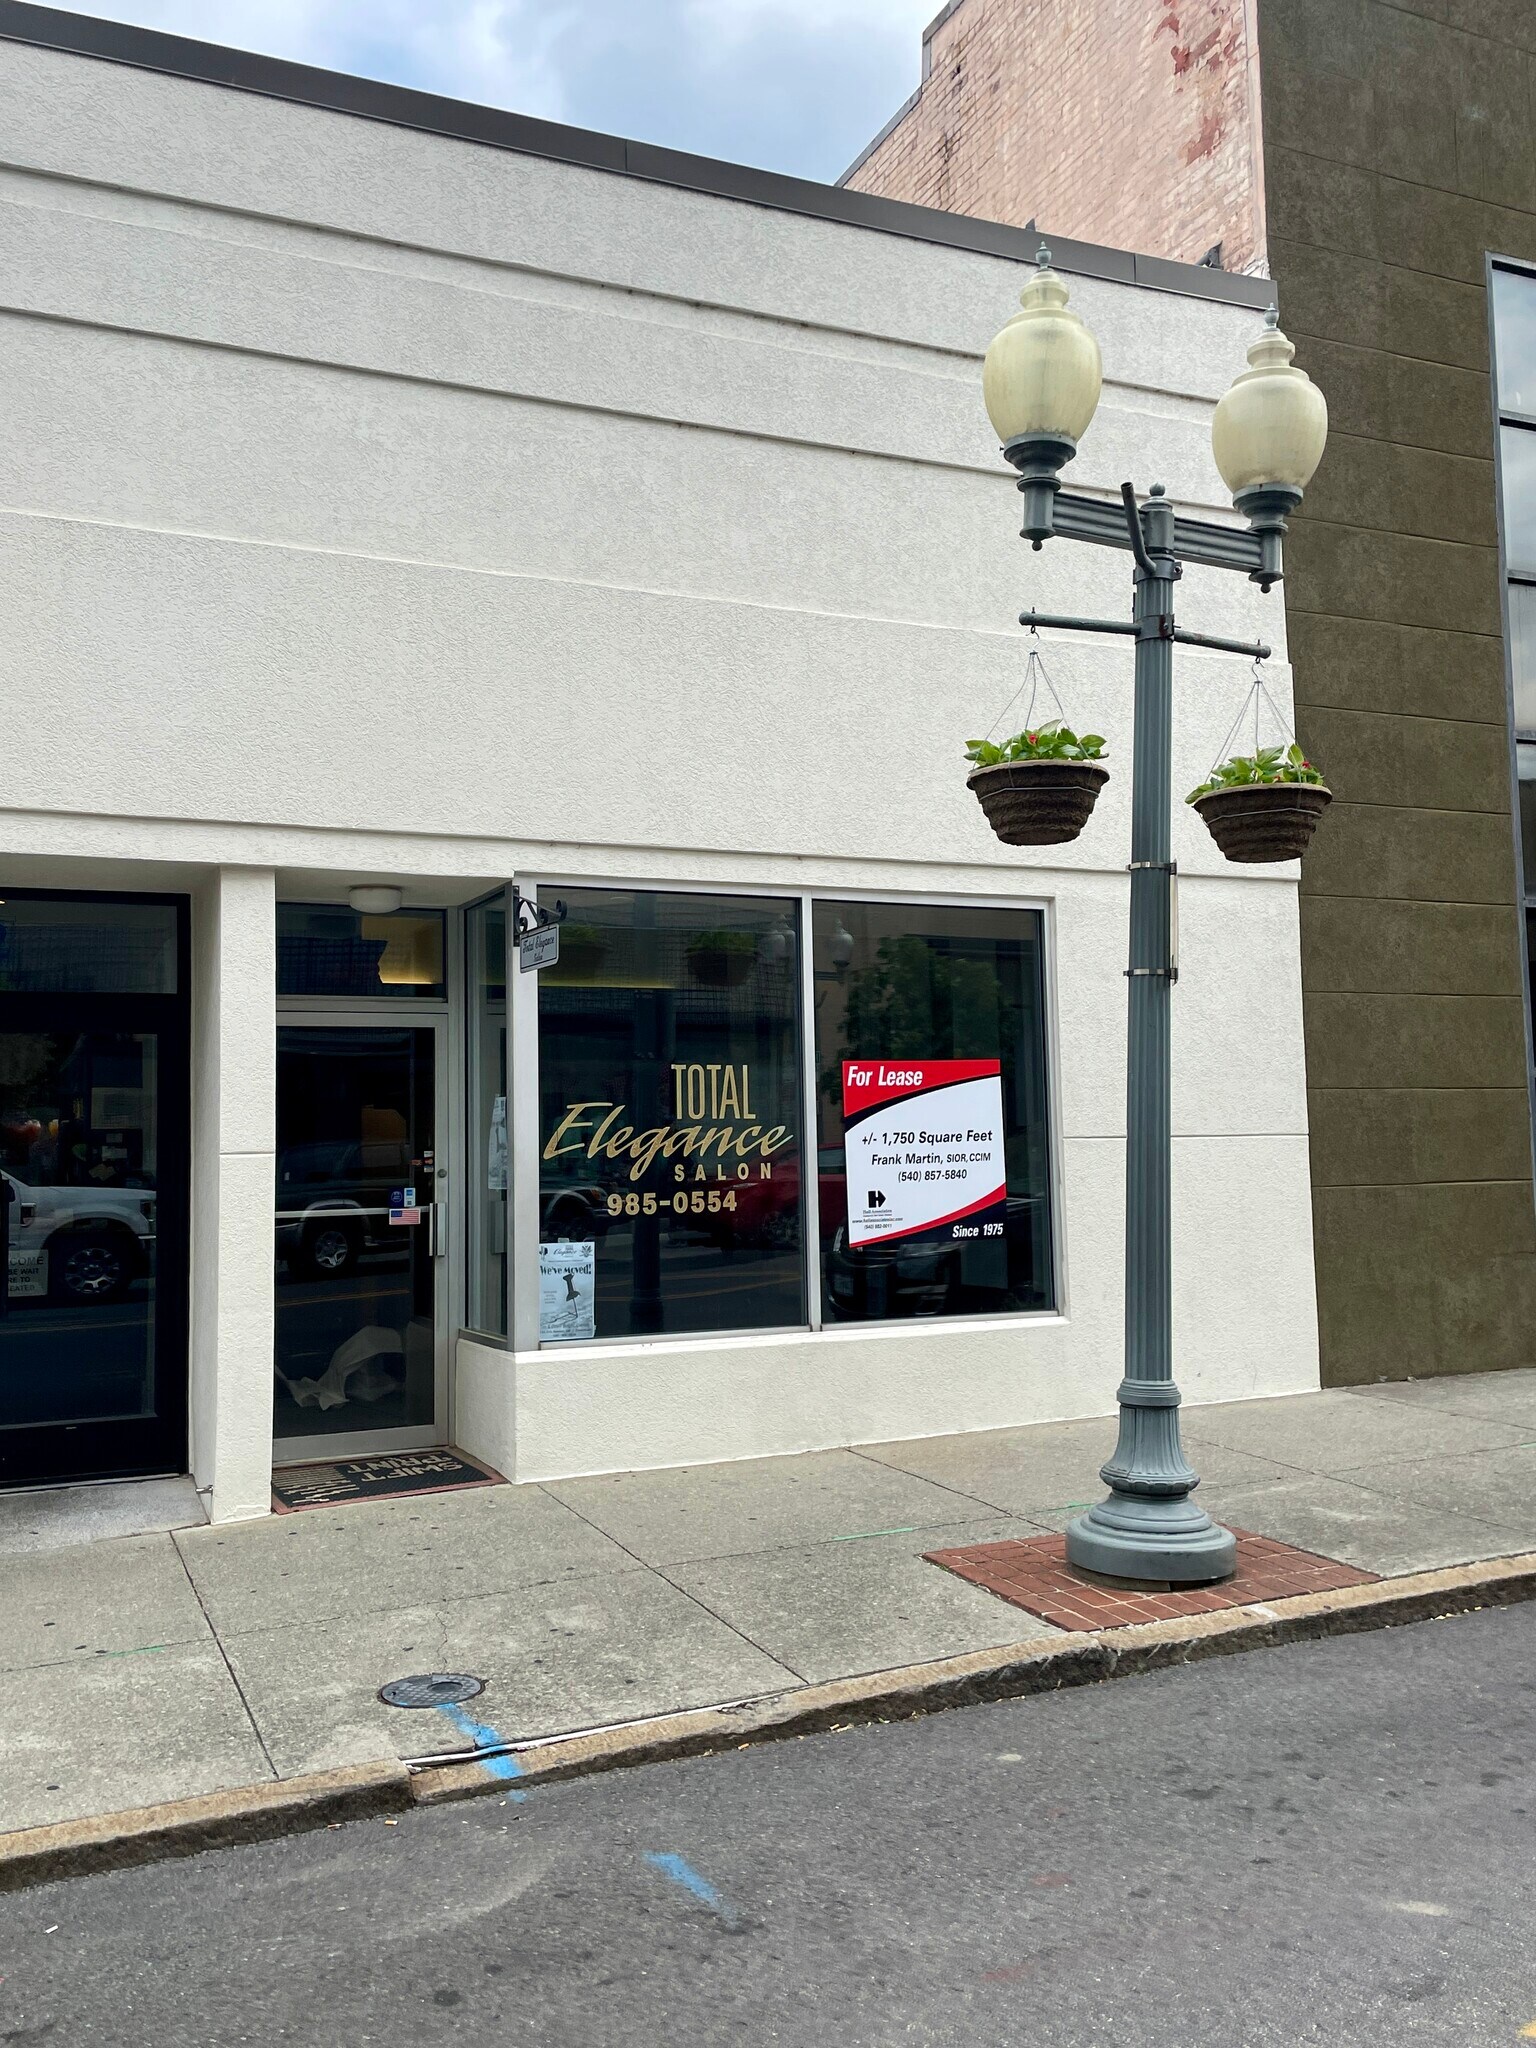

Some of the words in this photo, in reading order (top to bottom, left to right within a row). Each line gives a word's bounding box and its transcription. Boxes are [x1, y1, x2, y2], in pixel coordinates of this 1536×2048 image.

[847, 1065, 873, 1087] For
[878, 1065, 923, 1087] Lease
[671, 1063, 756, 1120] TOTAL
[542, 1101, 794, 1182] Elegance
[861, 1132, 878, 1146] +/-
[882, 1131, 915, 1146] 1,750
[918, 1130, 963, 1146] Square
[966, 1129, 993, 1142] Feet
[871, 1153, 902, 1166] Frank
[905, 1152, 944, 1165] Martin,
[674, 1162, 772, 1182] SALON
[898, 1171, 922, 1183] (540)
[924, 1169, 968, 1181] 857-5840
[606, 1190, 738, 1217] 985-0554
[952, 1225, 979, 1238] Since
[982, 1223, 1004, 1236] 1975
[10, 1256, 44, 1266] COME
[540, 1265, 562, 1276] We've
[9, 1284, 35, 1292] EATED
[347, 1454, 453, 1474] PRINT
[361, 1461, 463, 1482] SWIFT
